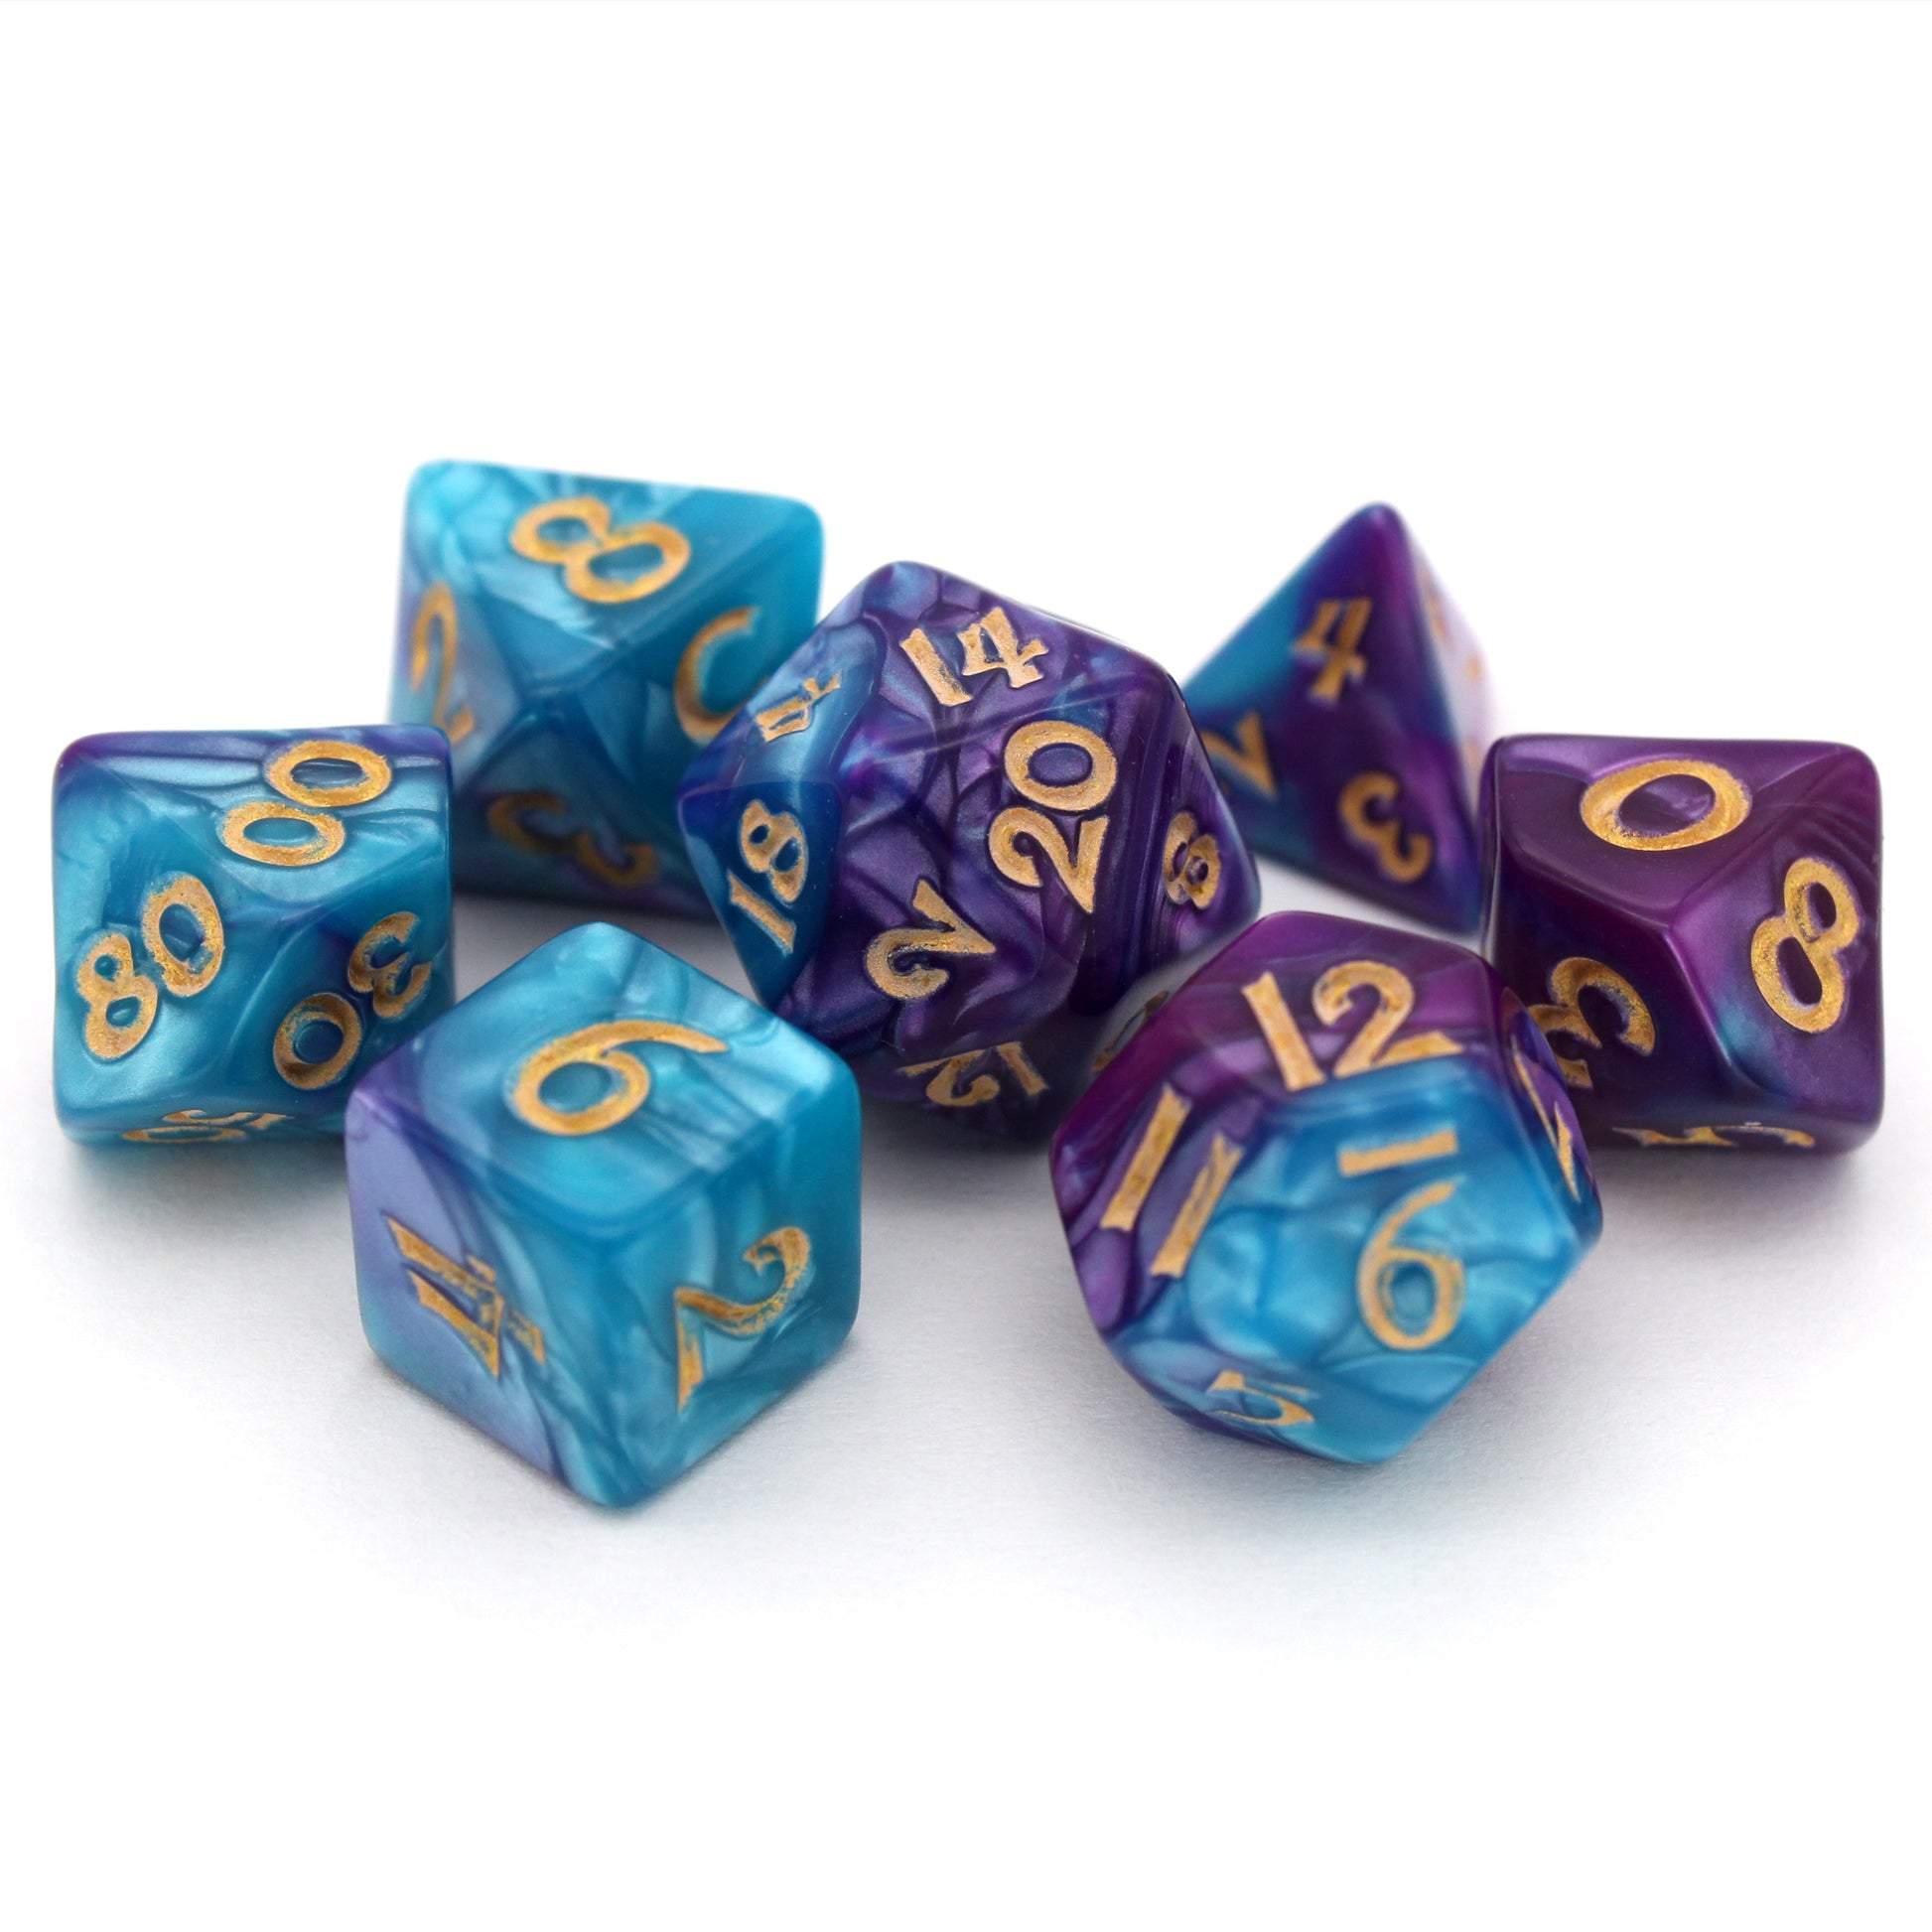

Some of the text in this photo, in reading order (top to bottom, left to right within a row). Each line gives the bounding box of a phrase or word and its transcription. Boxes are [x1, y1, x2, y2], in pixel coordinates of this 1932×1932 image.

[510, 496, 691, 603] 8
[900, 607, 1049, 707] 14
[1292, 599, 1373, 701] 4
[222, 740, 391, 867] 00
[988, 720, 1118, 913] 20
[1164, 811, 1221, 910] 8
[1340, 772, 1434, 882] 3
[1581, 759, 1752, 851] 0
[728, 798, 809, 953] 18
[76, 876, 224, 1059] 80
[273, 911, 432, 1090] 30
[865, 880, 996, 1000] 2
[1751, 857, 1861, 1034] 8
[511, 1020, 729, 1136] 6
[897, 1038, 1050, 1108] 12
[1242, 960, 1466, 1091] 12
[1529, 957, 1656, 1090] 3
[1101, 1083, 1245, 1278] 11
[673, 1227, 812, 1414] 2
